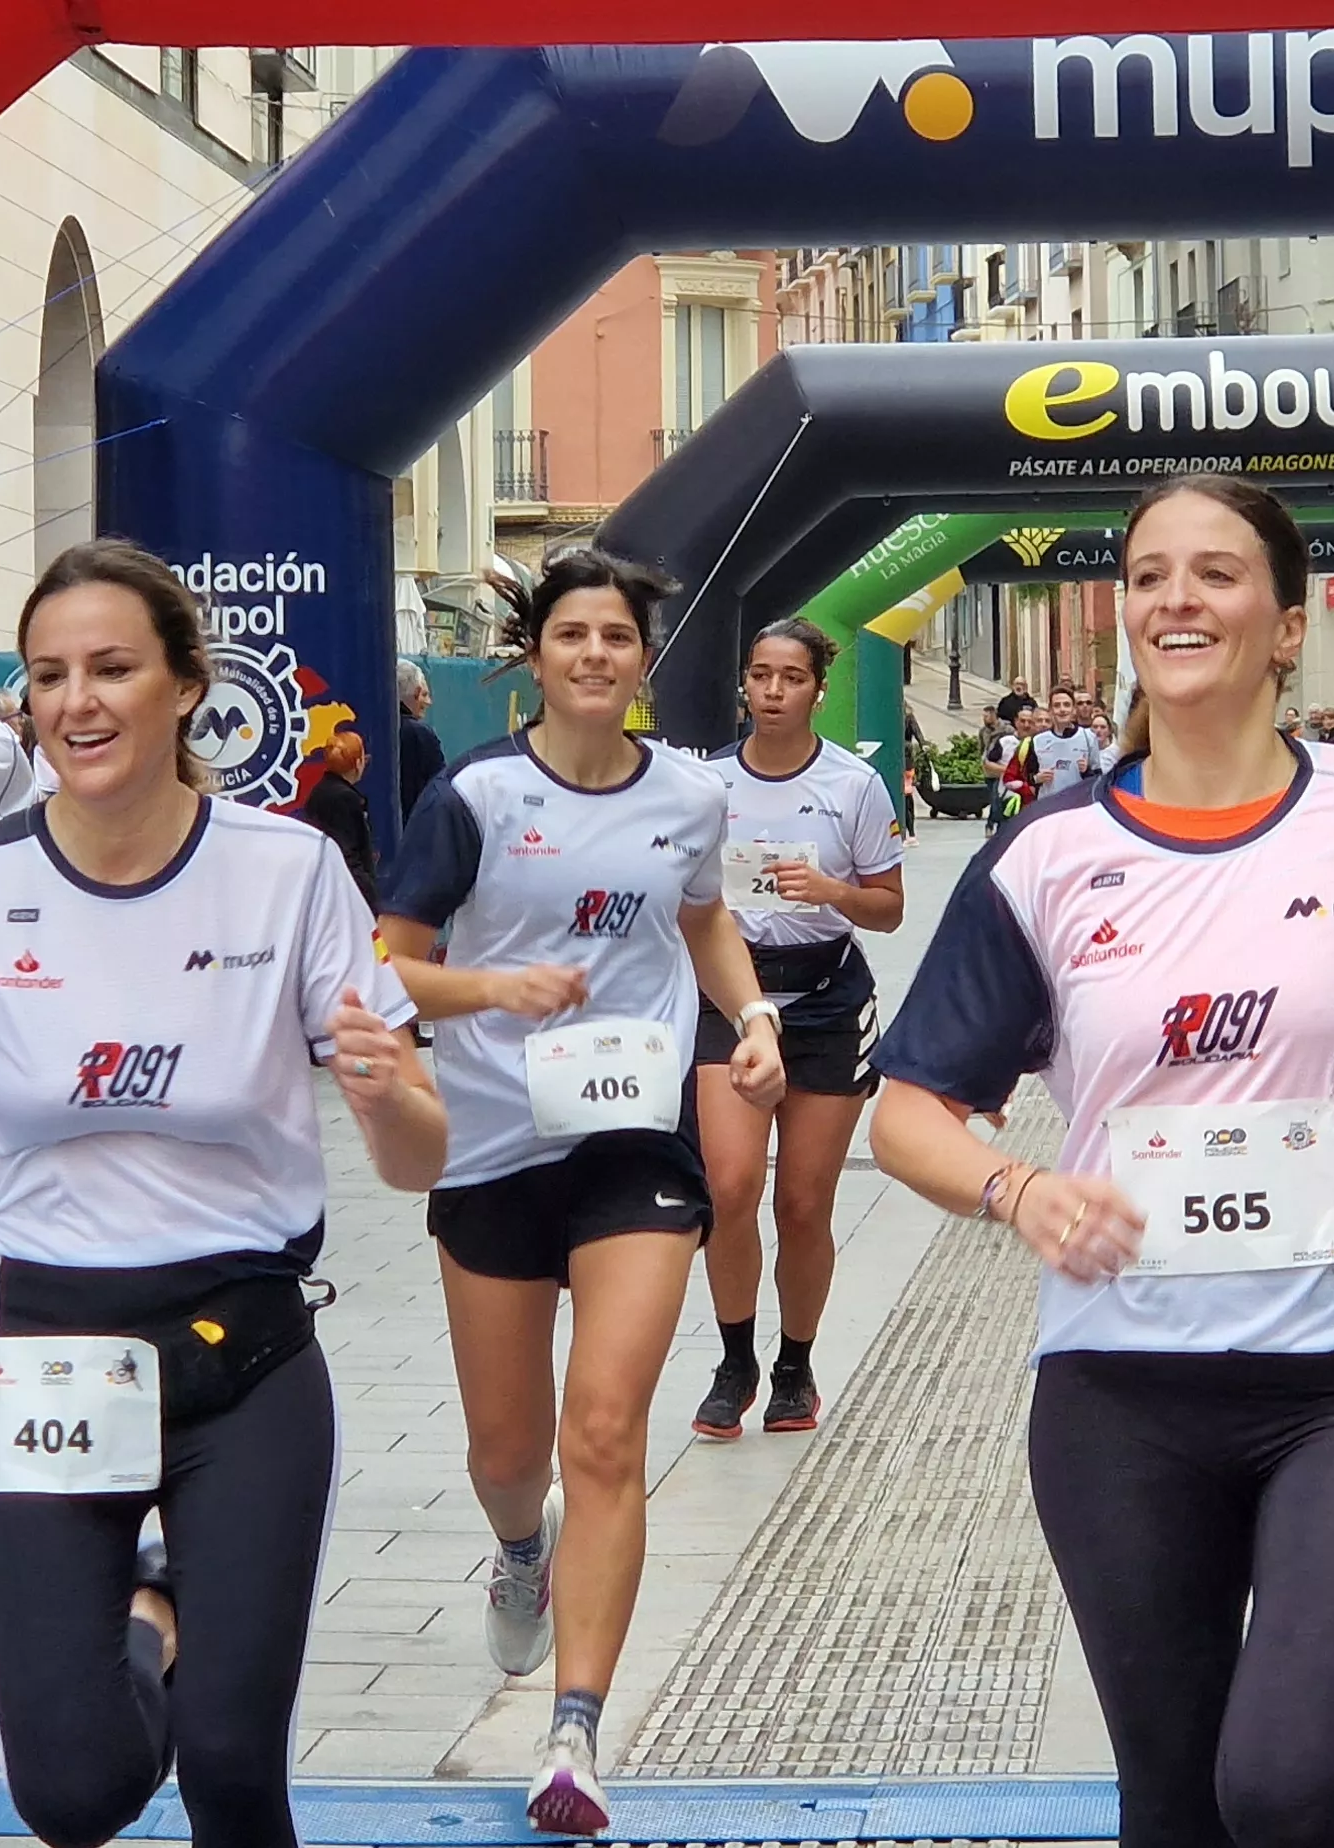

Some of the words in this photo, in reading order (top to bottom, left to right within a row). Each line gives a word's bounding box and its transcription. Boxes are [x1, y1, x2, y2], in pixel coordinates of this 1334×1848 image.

[1009, 456, 1078, 478] PÁSATE
[1080, 460, 1096, 476] A
[1098, 459, 1121, 475] LA
[1125, 456, 1244, 475] OPERADORA
[1056, 549, 1117, 567] CAJA
[169, 552, 326, 594] ndación
[195, 595, 285, 644] upol
[209, 767, 253, 787] LICÍA
[507, 845, 561, 856] Santander
[752, 877, 777, 894] 24
[223, 945, 276, 970] mupol
[1070, 943, 1146, 969] Santander
[580, 1076, 640, 1102] 406
[1131, 1149, 1182, 1160] Santander
[1183, 1191, 1271, 1234] 565
[14, 1419, 93, 1454] 404
